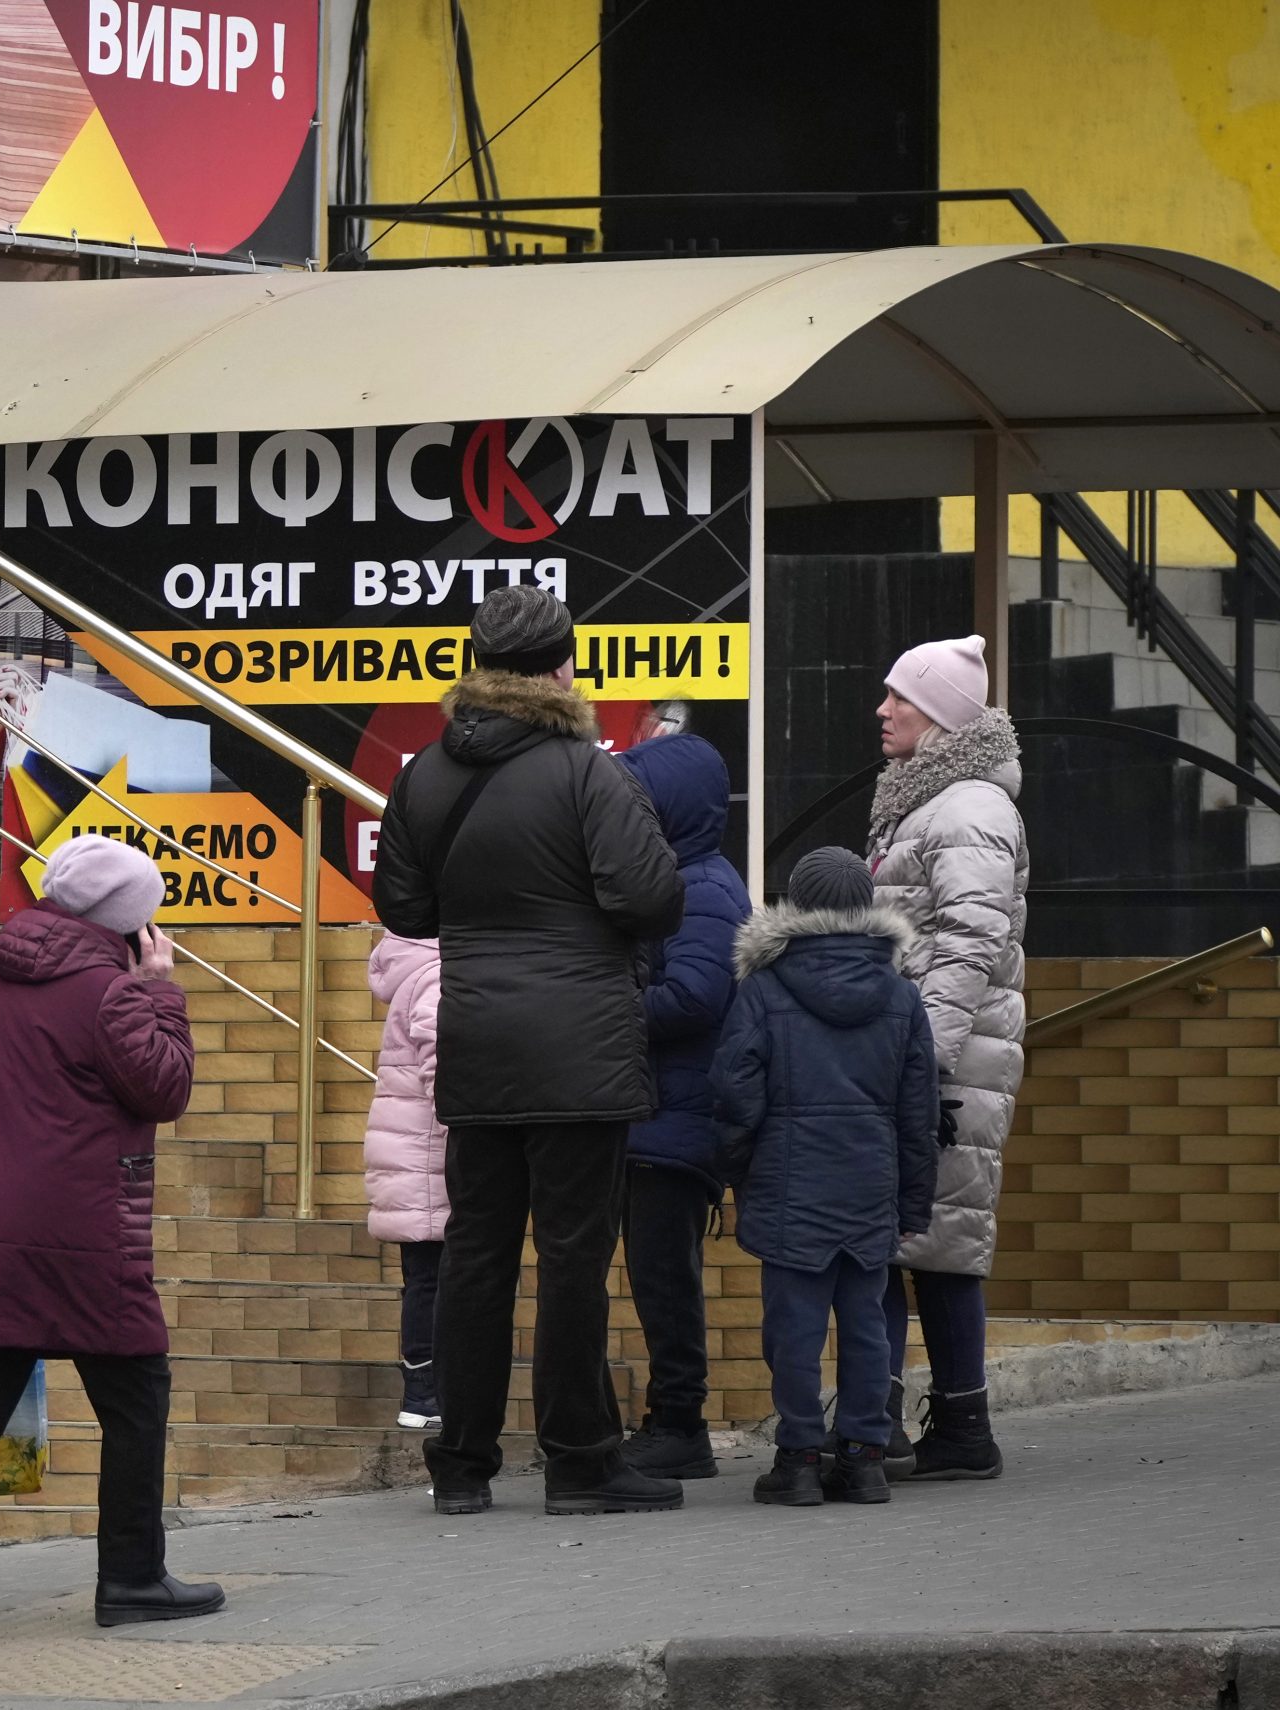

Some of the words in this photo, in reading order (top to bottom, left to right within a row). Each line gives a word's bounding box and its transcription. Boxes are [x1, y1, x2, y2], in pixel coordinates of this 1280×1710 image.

[88, 0, 258, 93] ВИБІР
[4, 416, 734, 543] КОНФІСКАТ
[163, 561, 316, 619] ОДЯГ
[354, 558, 567, 606] ВЗУТТЯ
[574, 635, 701, 689] ЦІНИ
[72, 824, 277, 860] КАЄМО
[160, 871, 238, 907] ВАС
